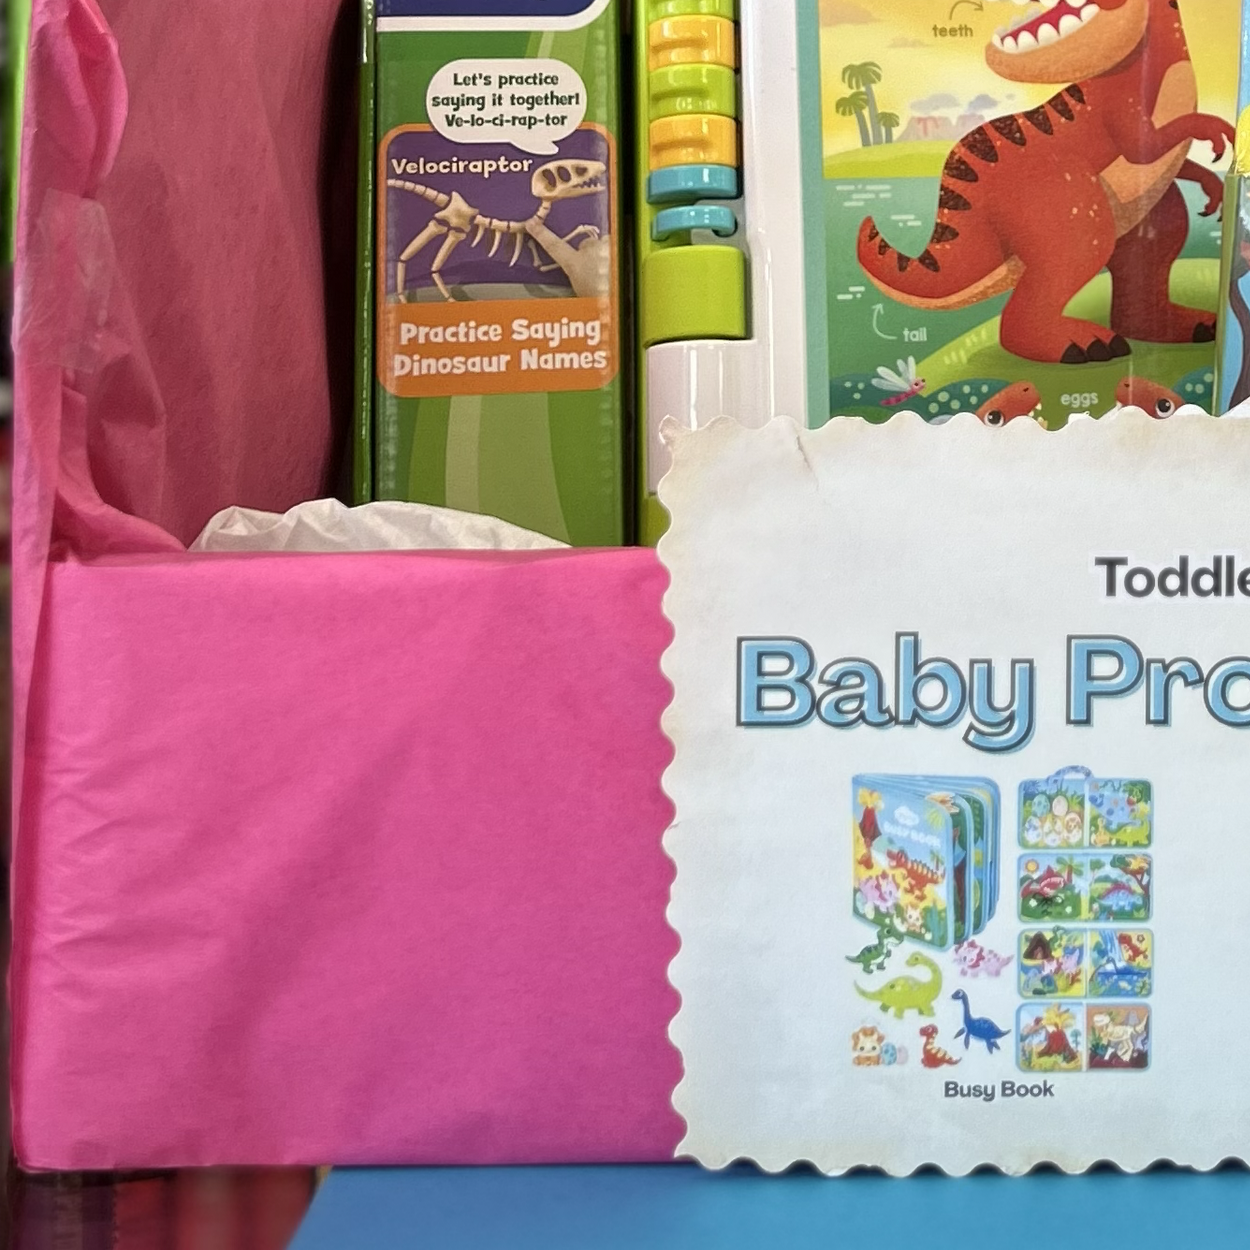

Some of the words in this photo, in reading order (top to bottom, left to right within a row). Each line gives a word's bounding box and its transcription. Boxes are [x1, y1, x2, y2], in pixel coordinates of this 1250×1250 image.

[931, 23, 974, 38] teeth
[453, 73, 492, 86] Let's
[499, 73, 559, 88] practice
[432, 93, 486, 111] saying
[492, 93, 503, 106] it
[510, 91, 580, 110] together!
[445, 113, 568, 129] Ve-lo-ci-rap-tor
[391, 156, 533, 178] Velociraptor
[400, 321, 502, 345] Practice
[511, 317, 601, 347] Saying
[902, 327, 927, 342] tail
[393, 353, 511, 376] Dinosaur
[520, 348, 608, 370] Names
[1060, 392, 1099, 408] eggs
[735, 631, 1037, 752] Baby
[944, 1080, 996, 1102] Busy
[1001, 1080, 1055, 1098] Book
